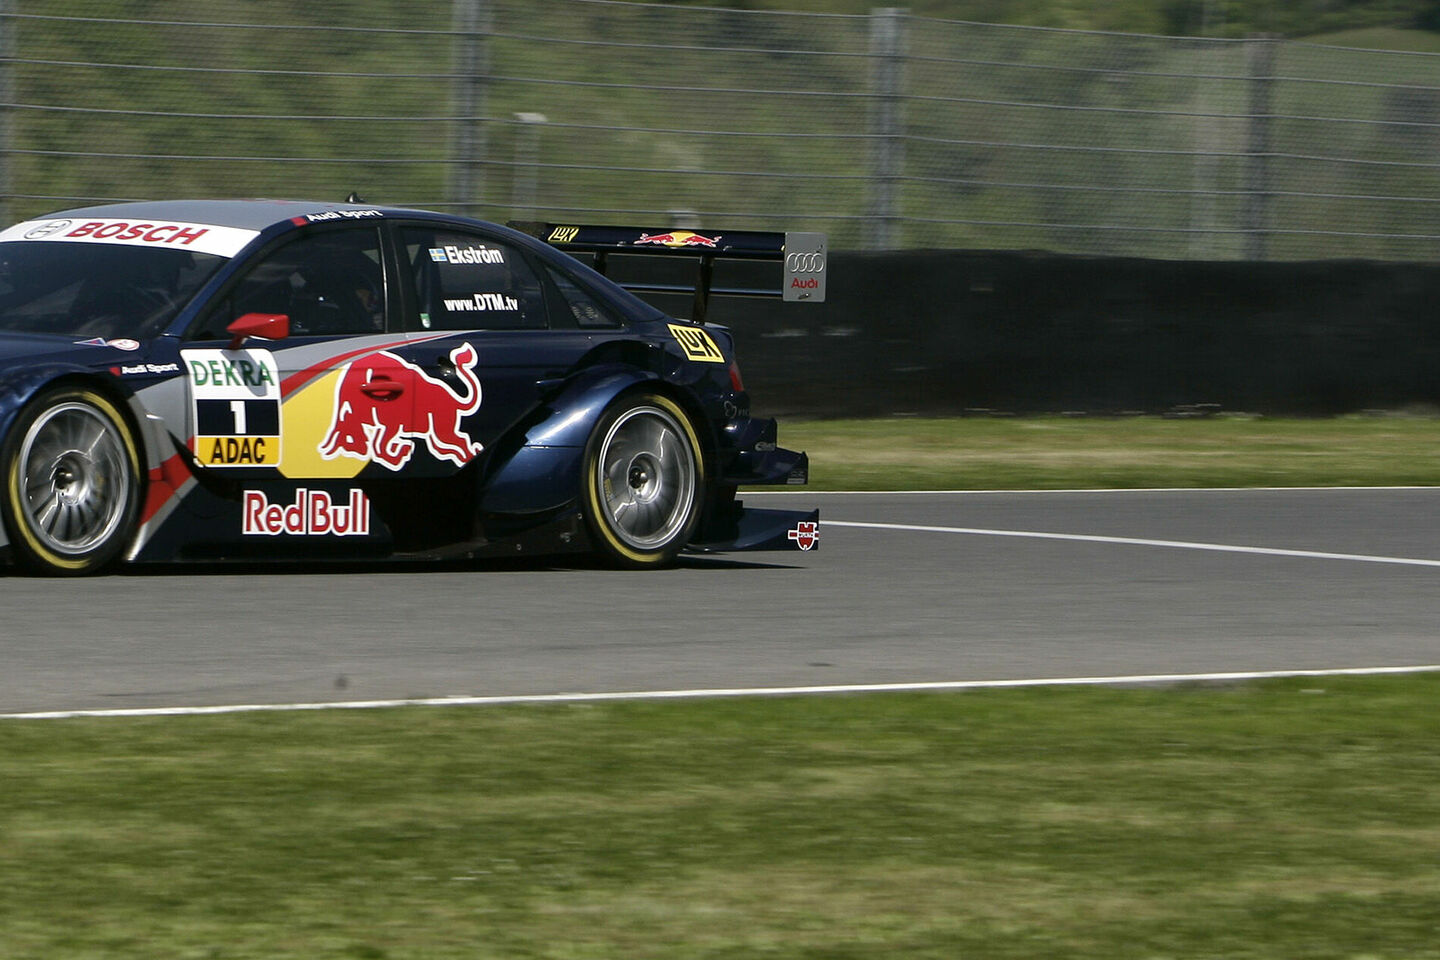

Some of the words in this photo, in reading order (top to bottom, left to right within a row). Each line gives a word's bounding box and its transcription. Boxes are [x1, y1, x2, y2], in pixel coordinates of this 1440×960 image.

[306, 211, 340, 222] Audi
[339, 209, 383, 219] Sport
[65, 221, 210, 245] BOSCH
[444, 245, 505, 264] Ekström
[791, 277, 819, 289] Audi
[444, 293, 519, 311] www.DTM.tv
[121, 365, 148, 374] Audi
[146, 363, 179, 374] Sport
[189, 360, 275, 386] DEKRA
[230, 400, 246, 434] 1
[211, 437, 265, 463] ADAC
